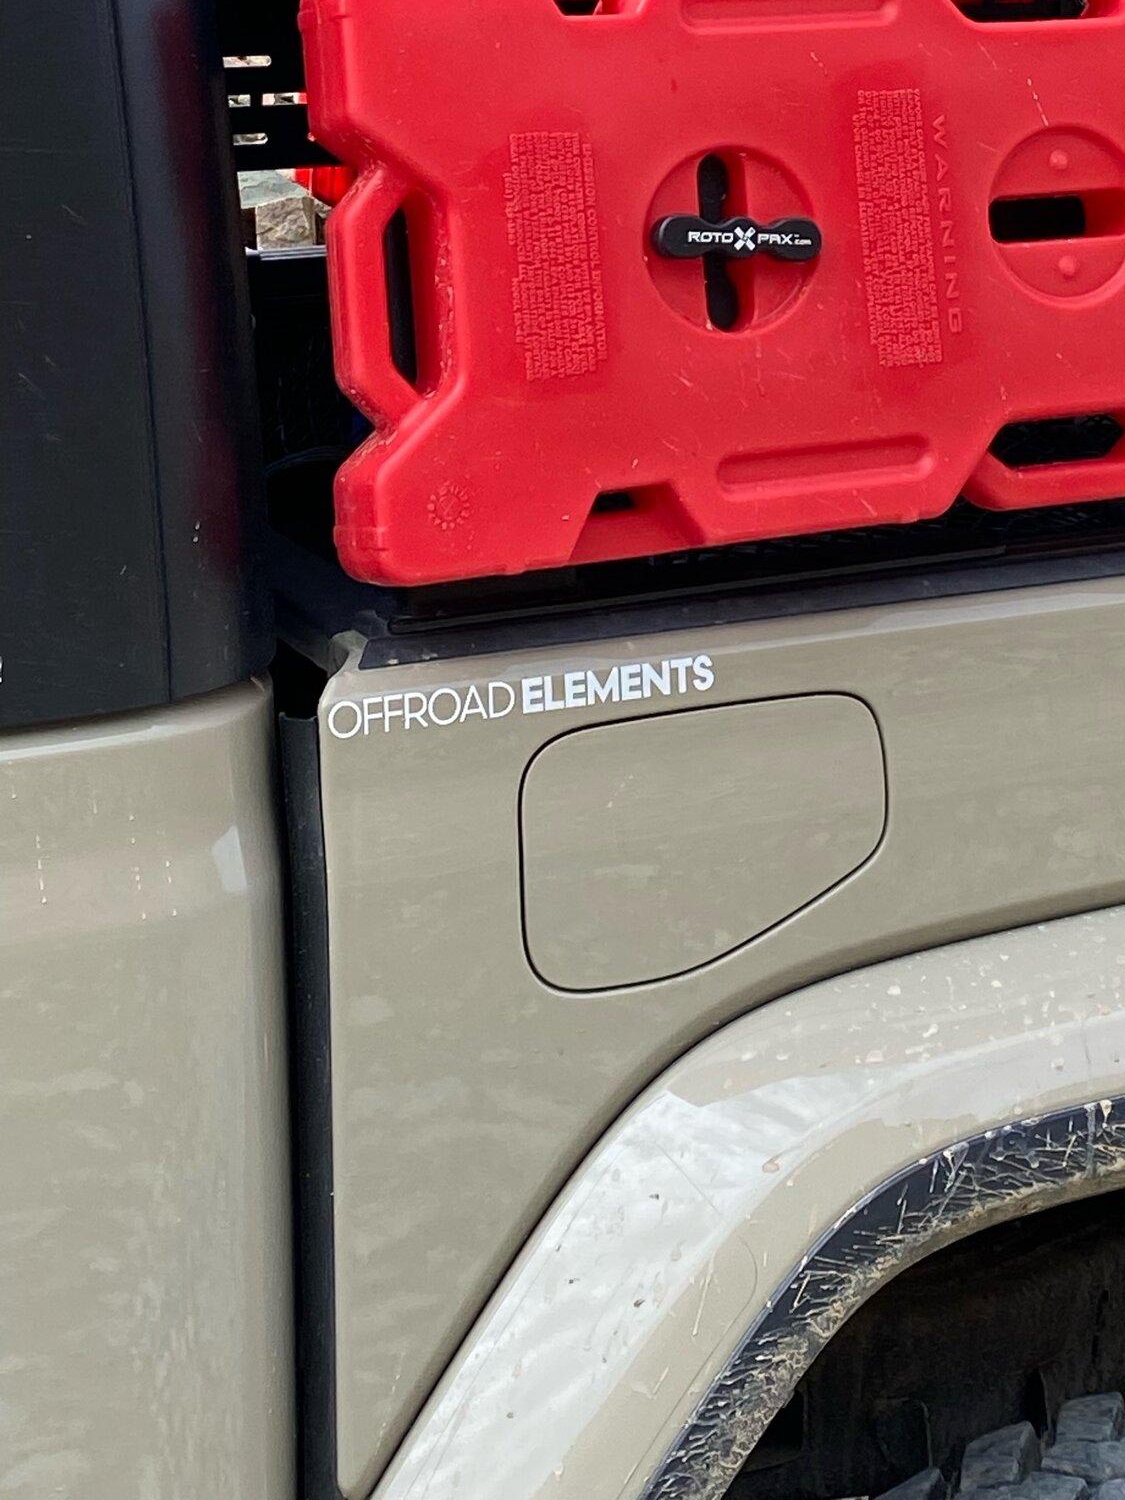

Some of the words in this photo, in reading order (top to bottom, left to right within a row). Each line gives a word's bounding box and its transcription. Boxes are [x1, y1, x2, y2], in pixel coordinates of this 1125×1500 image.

[687, 231, 734, 244] ROTO
[929, 114, 963, 333] WARNING
[327, 680, 516, 739] OFFROAD
[521, 654, 715, 714] ELEMENTS
